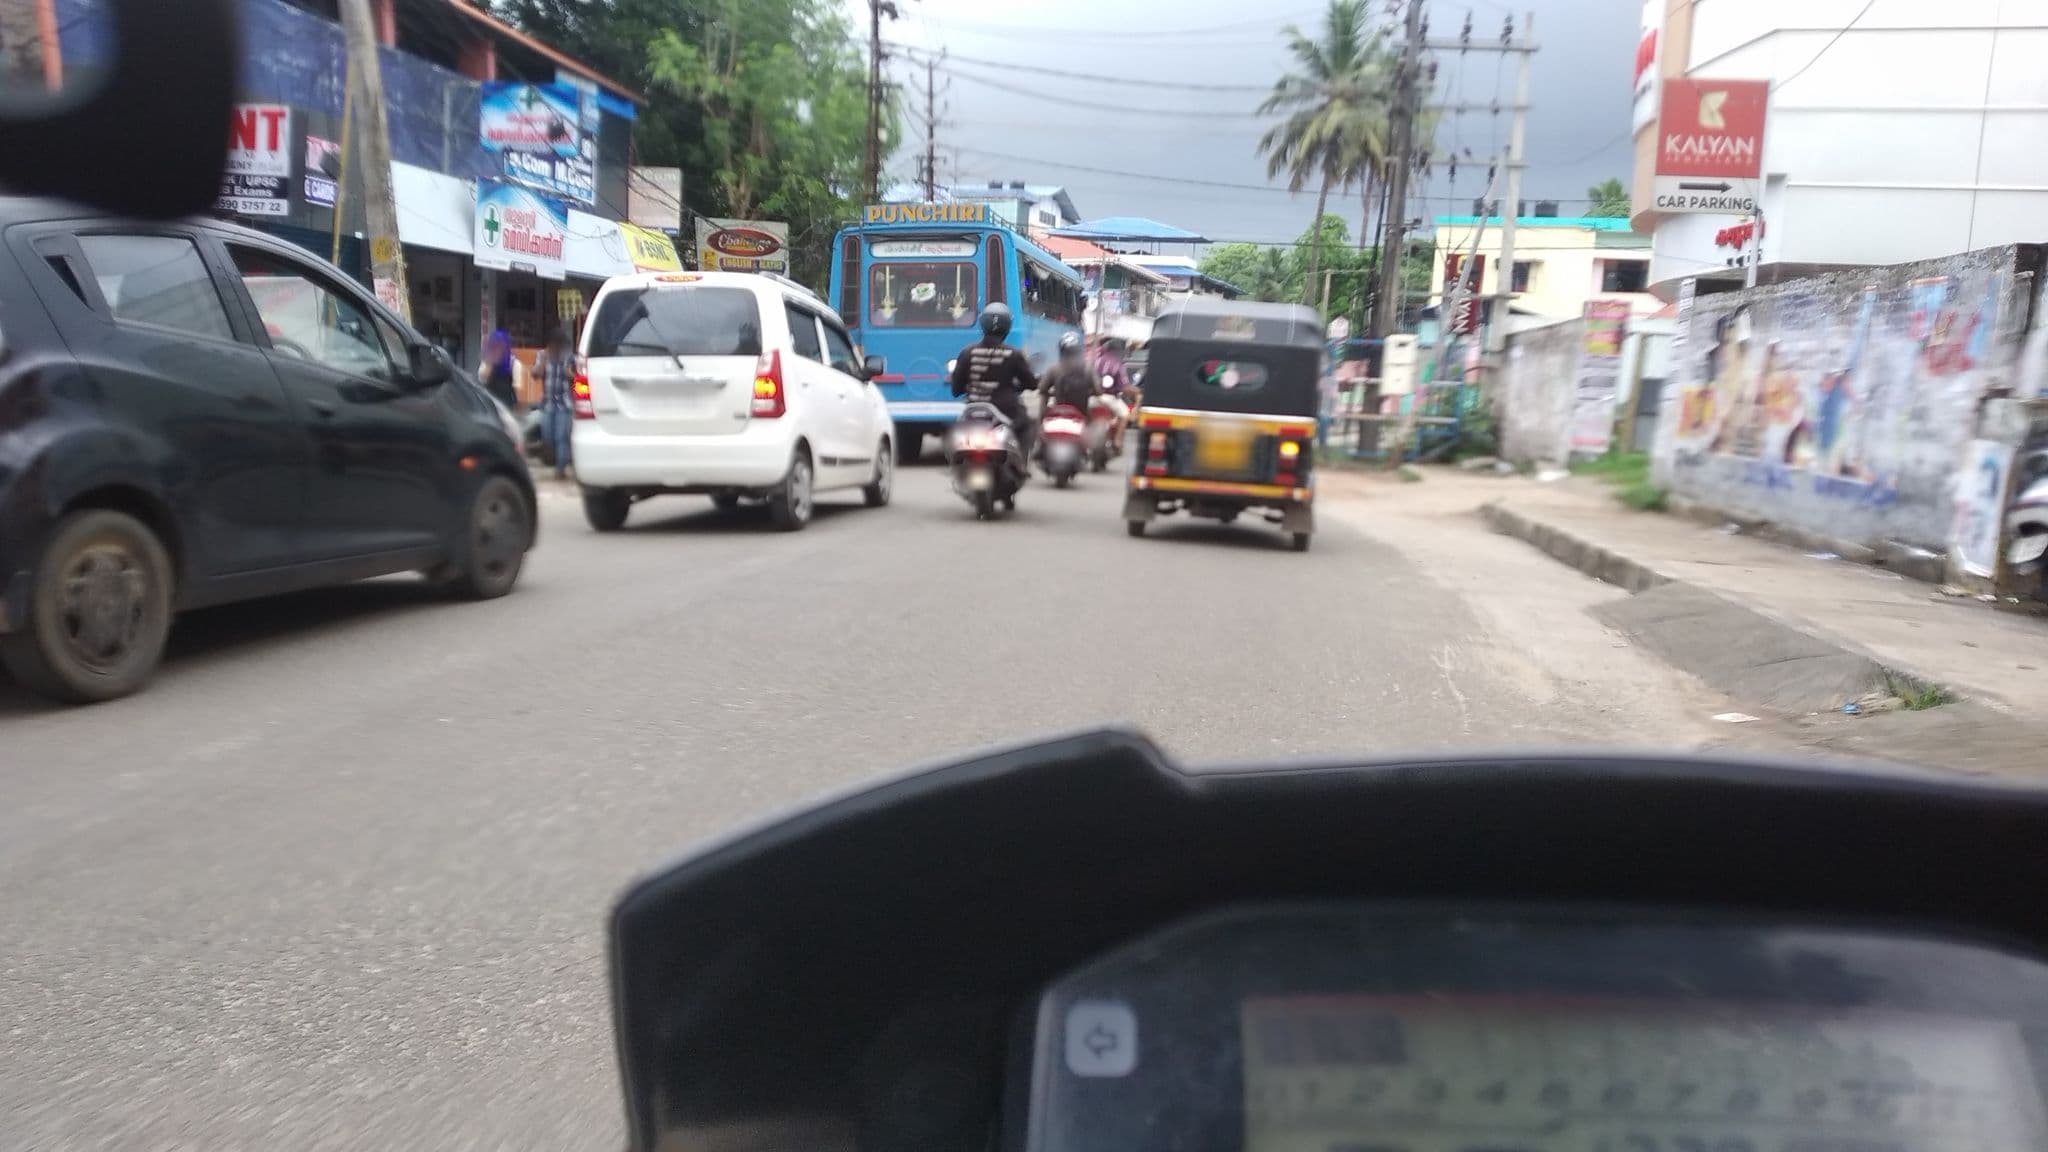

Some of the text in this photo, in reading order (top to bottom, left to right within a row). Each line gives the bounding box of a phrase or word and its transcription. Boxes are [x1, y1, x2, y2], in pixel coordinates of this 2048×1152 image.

[1665, 133, 1755, 156] KALYAN
[245, 176, 280, 188] UPSC
[233, 186, 274, 198] Exams
[241, 200, 266, 211] 5757
[269, 201, 281, 212] 22
[1656, 195, 1753, 211] CAR PARKING
[866, 203, 987, 224] PUNCHIRI
[643, 238, 671, 262] BSNL
[1451, 281, 1474, 333] ALYAN
